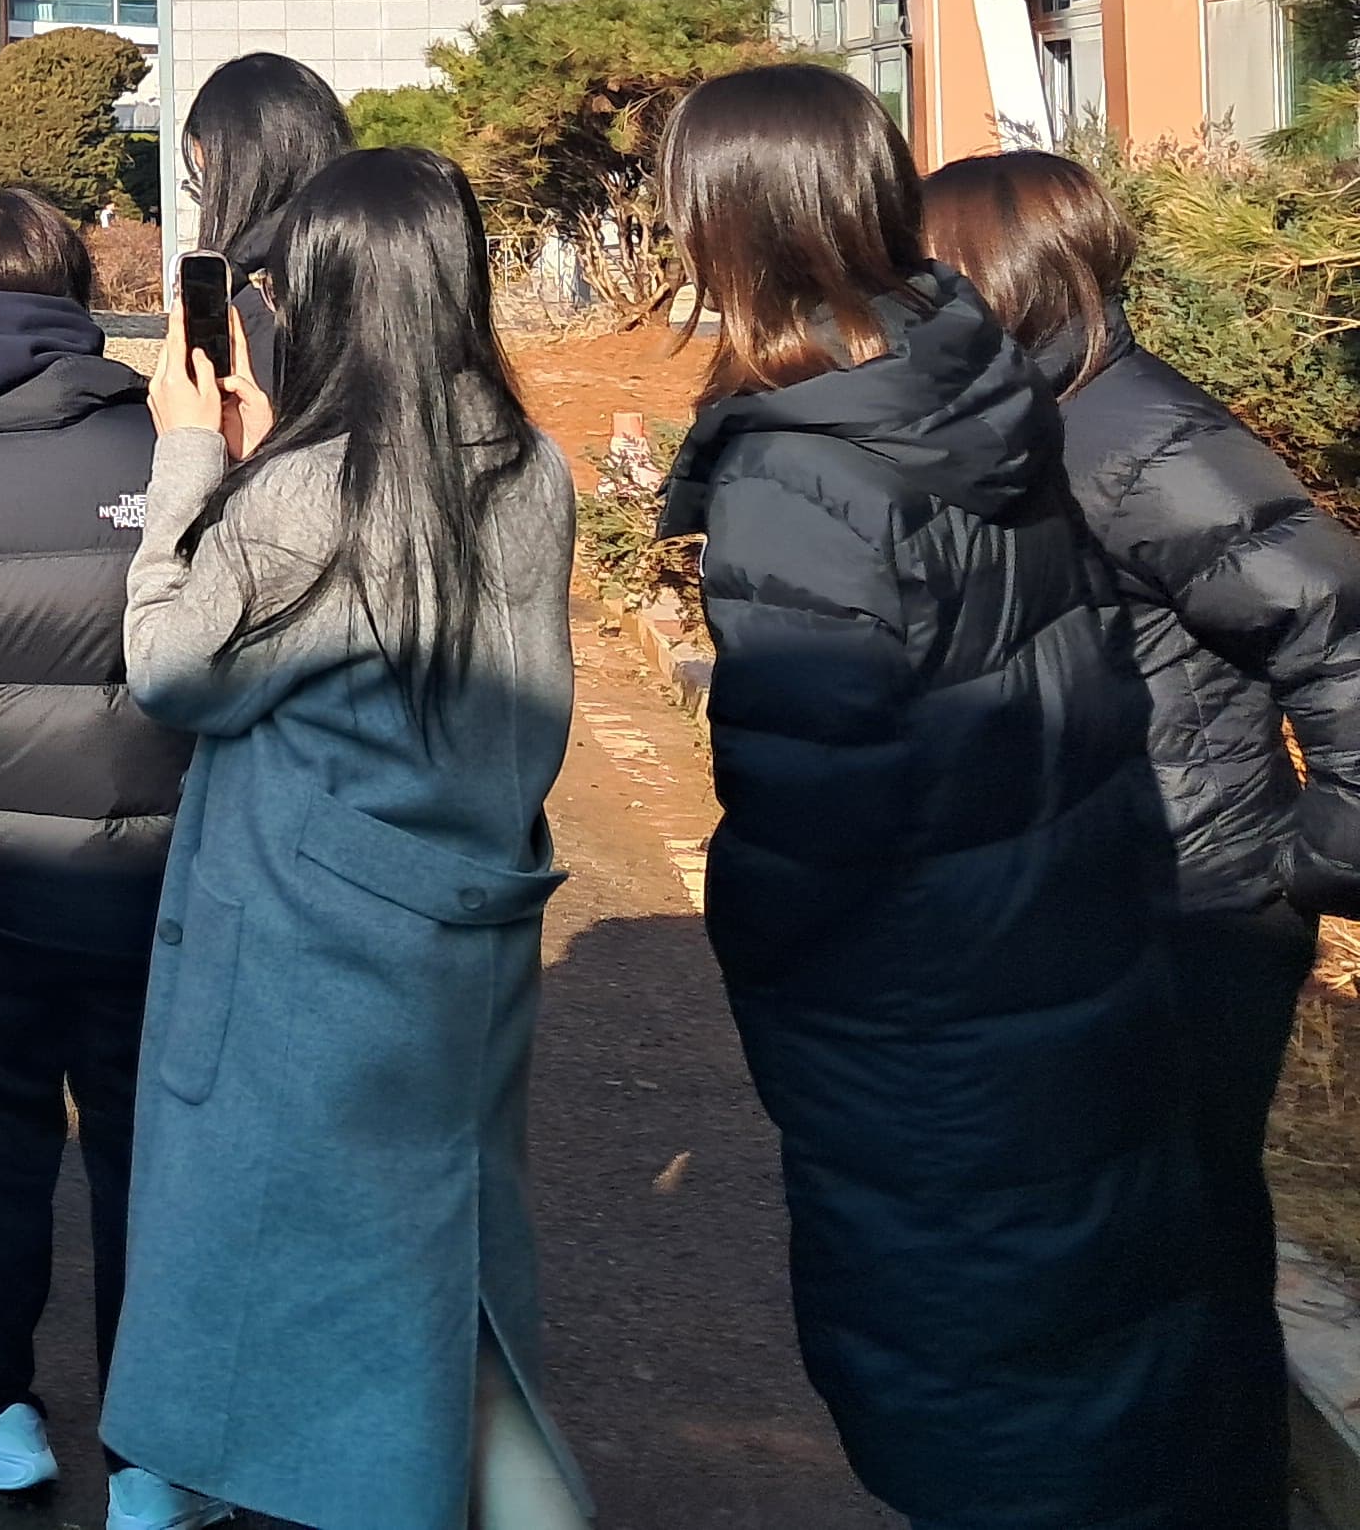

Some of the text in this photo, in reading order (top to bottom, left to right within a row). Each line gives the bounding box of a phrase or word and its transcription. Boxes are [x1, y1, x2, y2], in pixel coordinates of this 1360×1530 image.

[118, 494, 147, 506] THE
[98, 505, 146, 518] NORTH
[113, 516, 145, 528] FACE
